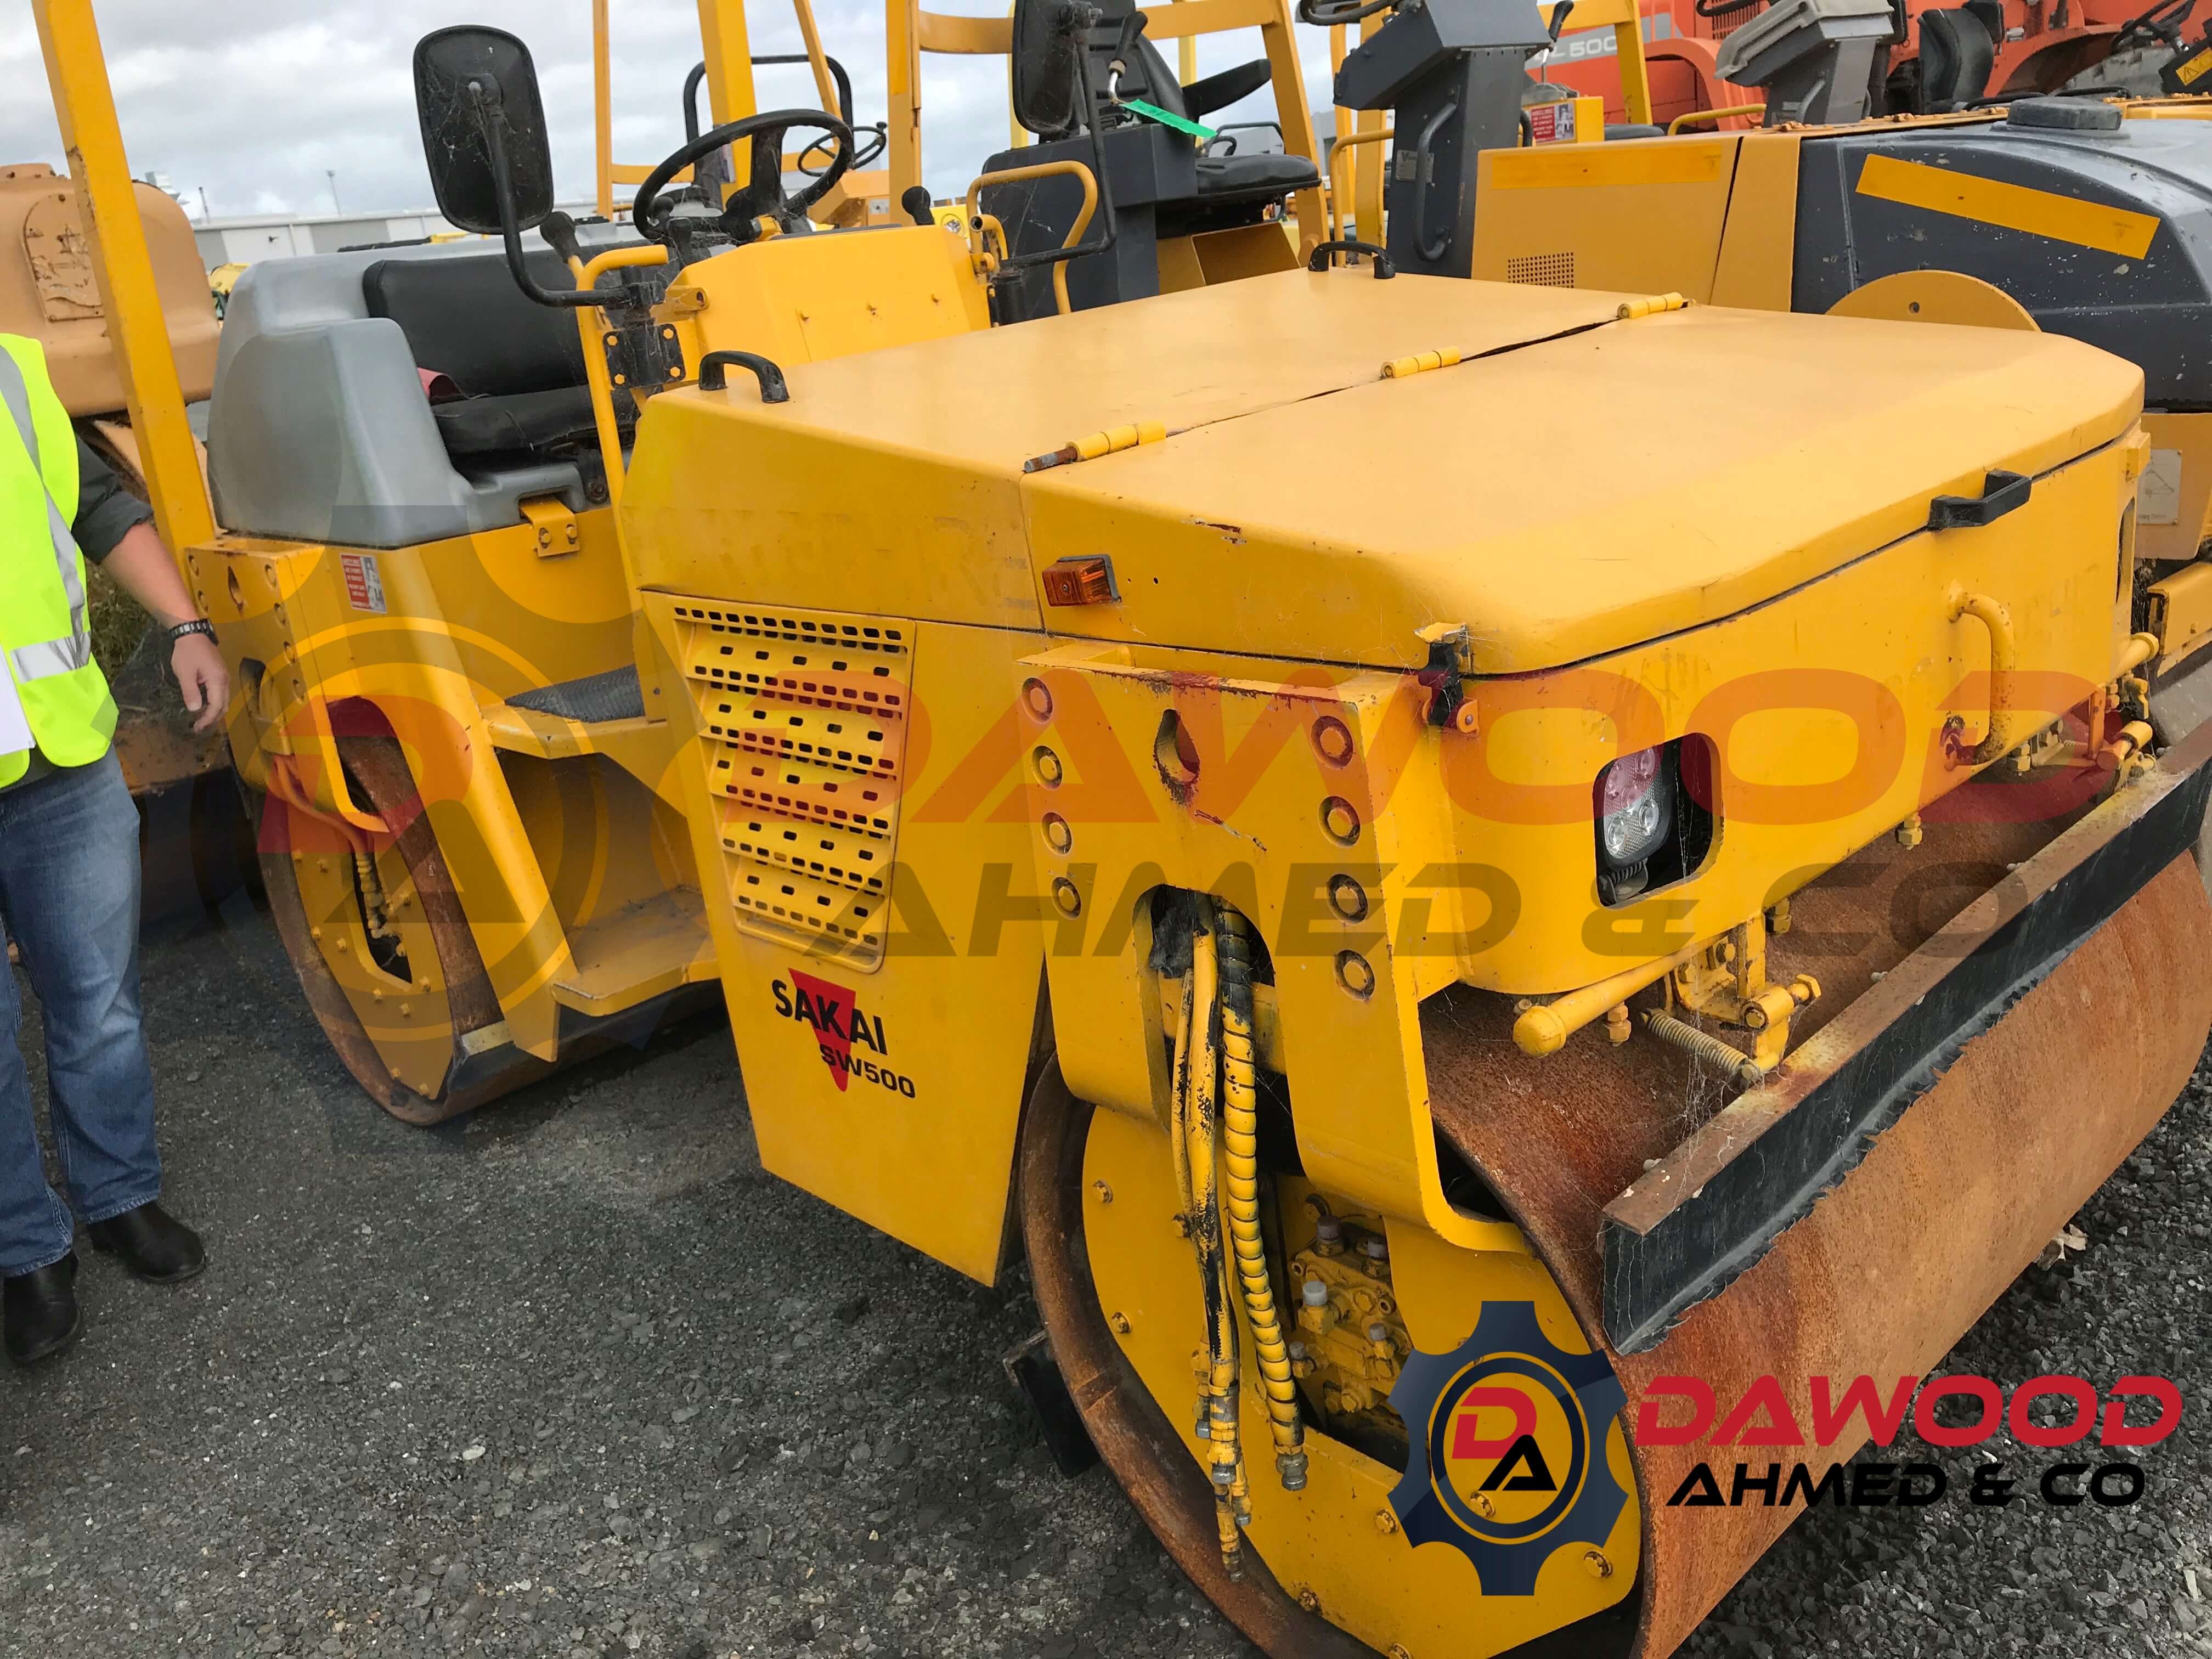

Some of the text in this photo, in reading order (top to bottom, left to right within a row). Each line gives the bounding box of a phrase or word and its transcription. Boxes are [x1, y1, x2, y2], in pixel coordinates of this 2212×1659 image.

[1570, 36, 1617, 57] 500
[772, 979, 888, 1056] SAKAI
[820, 1044, 916, 1098] SW500
